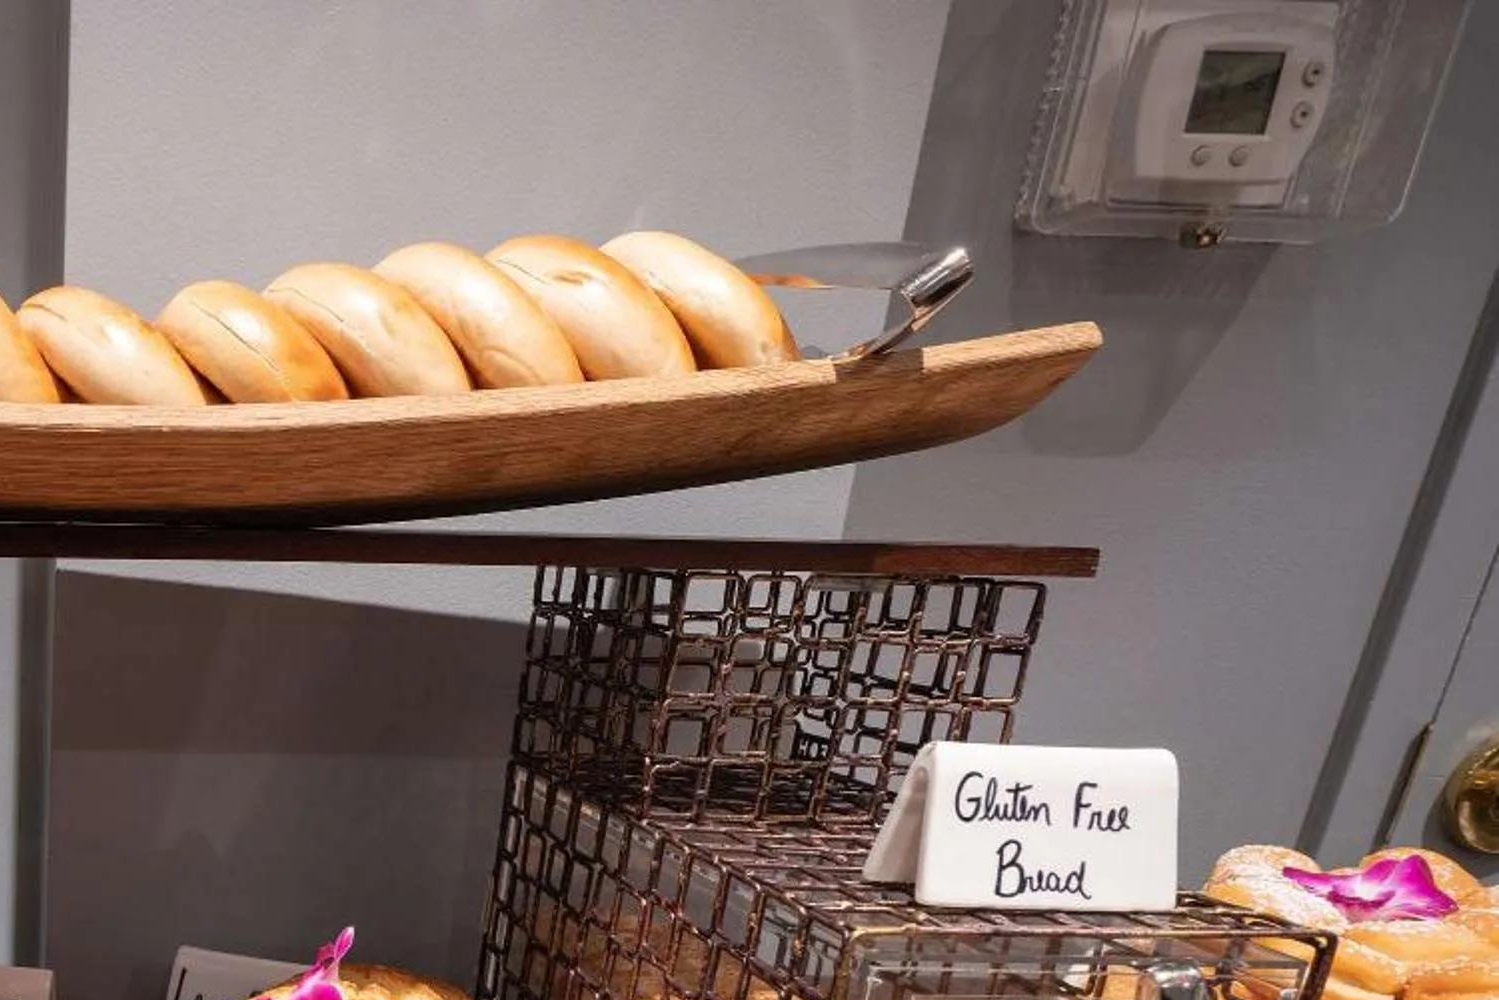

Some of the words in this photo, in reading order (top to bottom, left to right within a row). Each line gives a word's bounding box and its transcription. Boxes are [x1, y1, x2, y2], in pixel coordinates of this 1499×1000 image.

[954, 770, 1052, 827] Gluten
[1073, 781, 1131, 833] Free
[994, 838, 1093, 900] Bread
